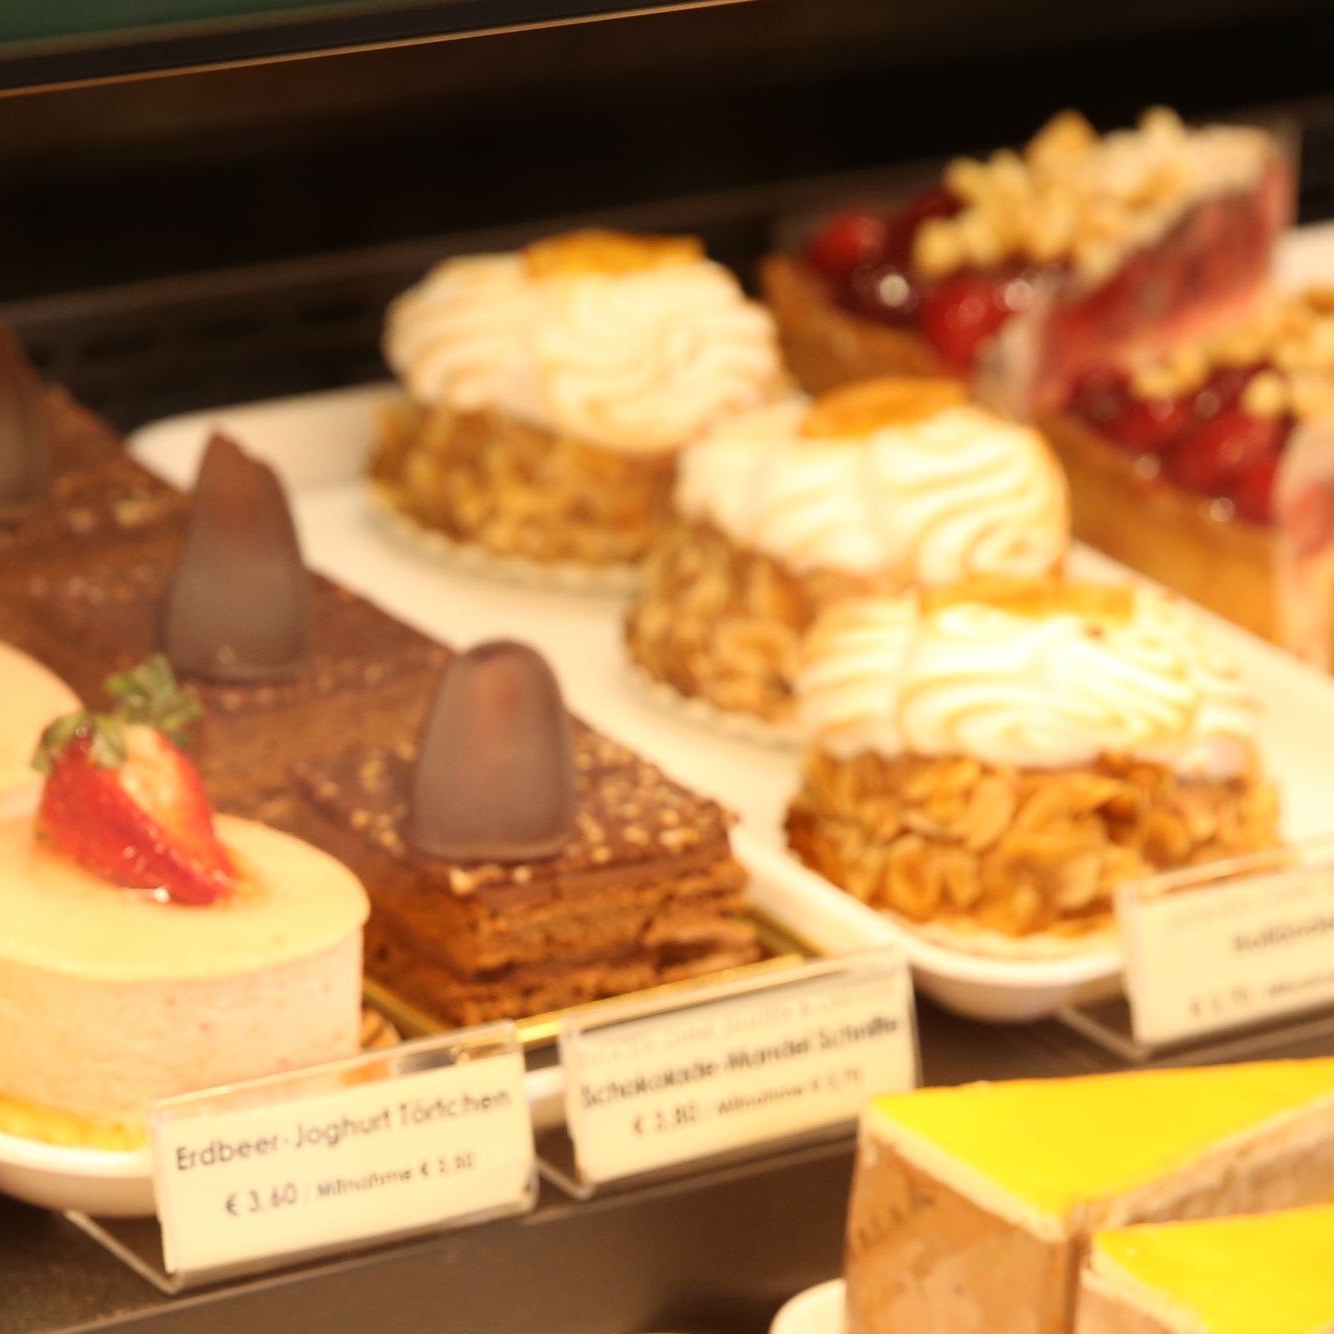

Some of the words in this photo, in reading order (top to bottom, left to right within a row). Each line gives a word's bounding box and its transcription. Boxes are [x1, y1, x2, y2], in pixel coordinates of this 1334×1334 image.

[175, 1110, 395, 1172] Erdbeer-Joghurt
[398, 1086, 511, 1124] Törtchen
[224, 1193, 239, 1217] €
[248, 1182, 299, 1214] 3,60
[316, 1167, 413, 1200] Mitnahme
